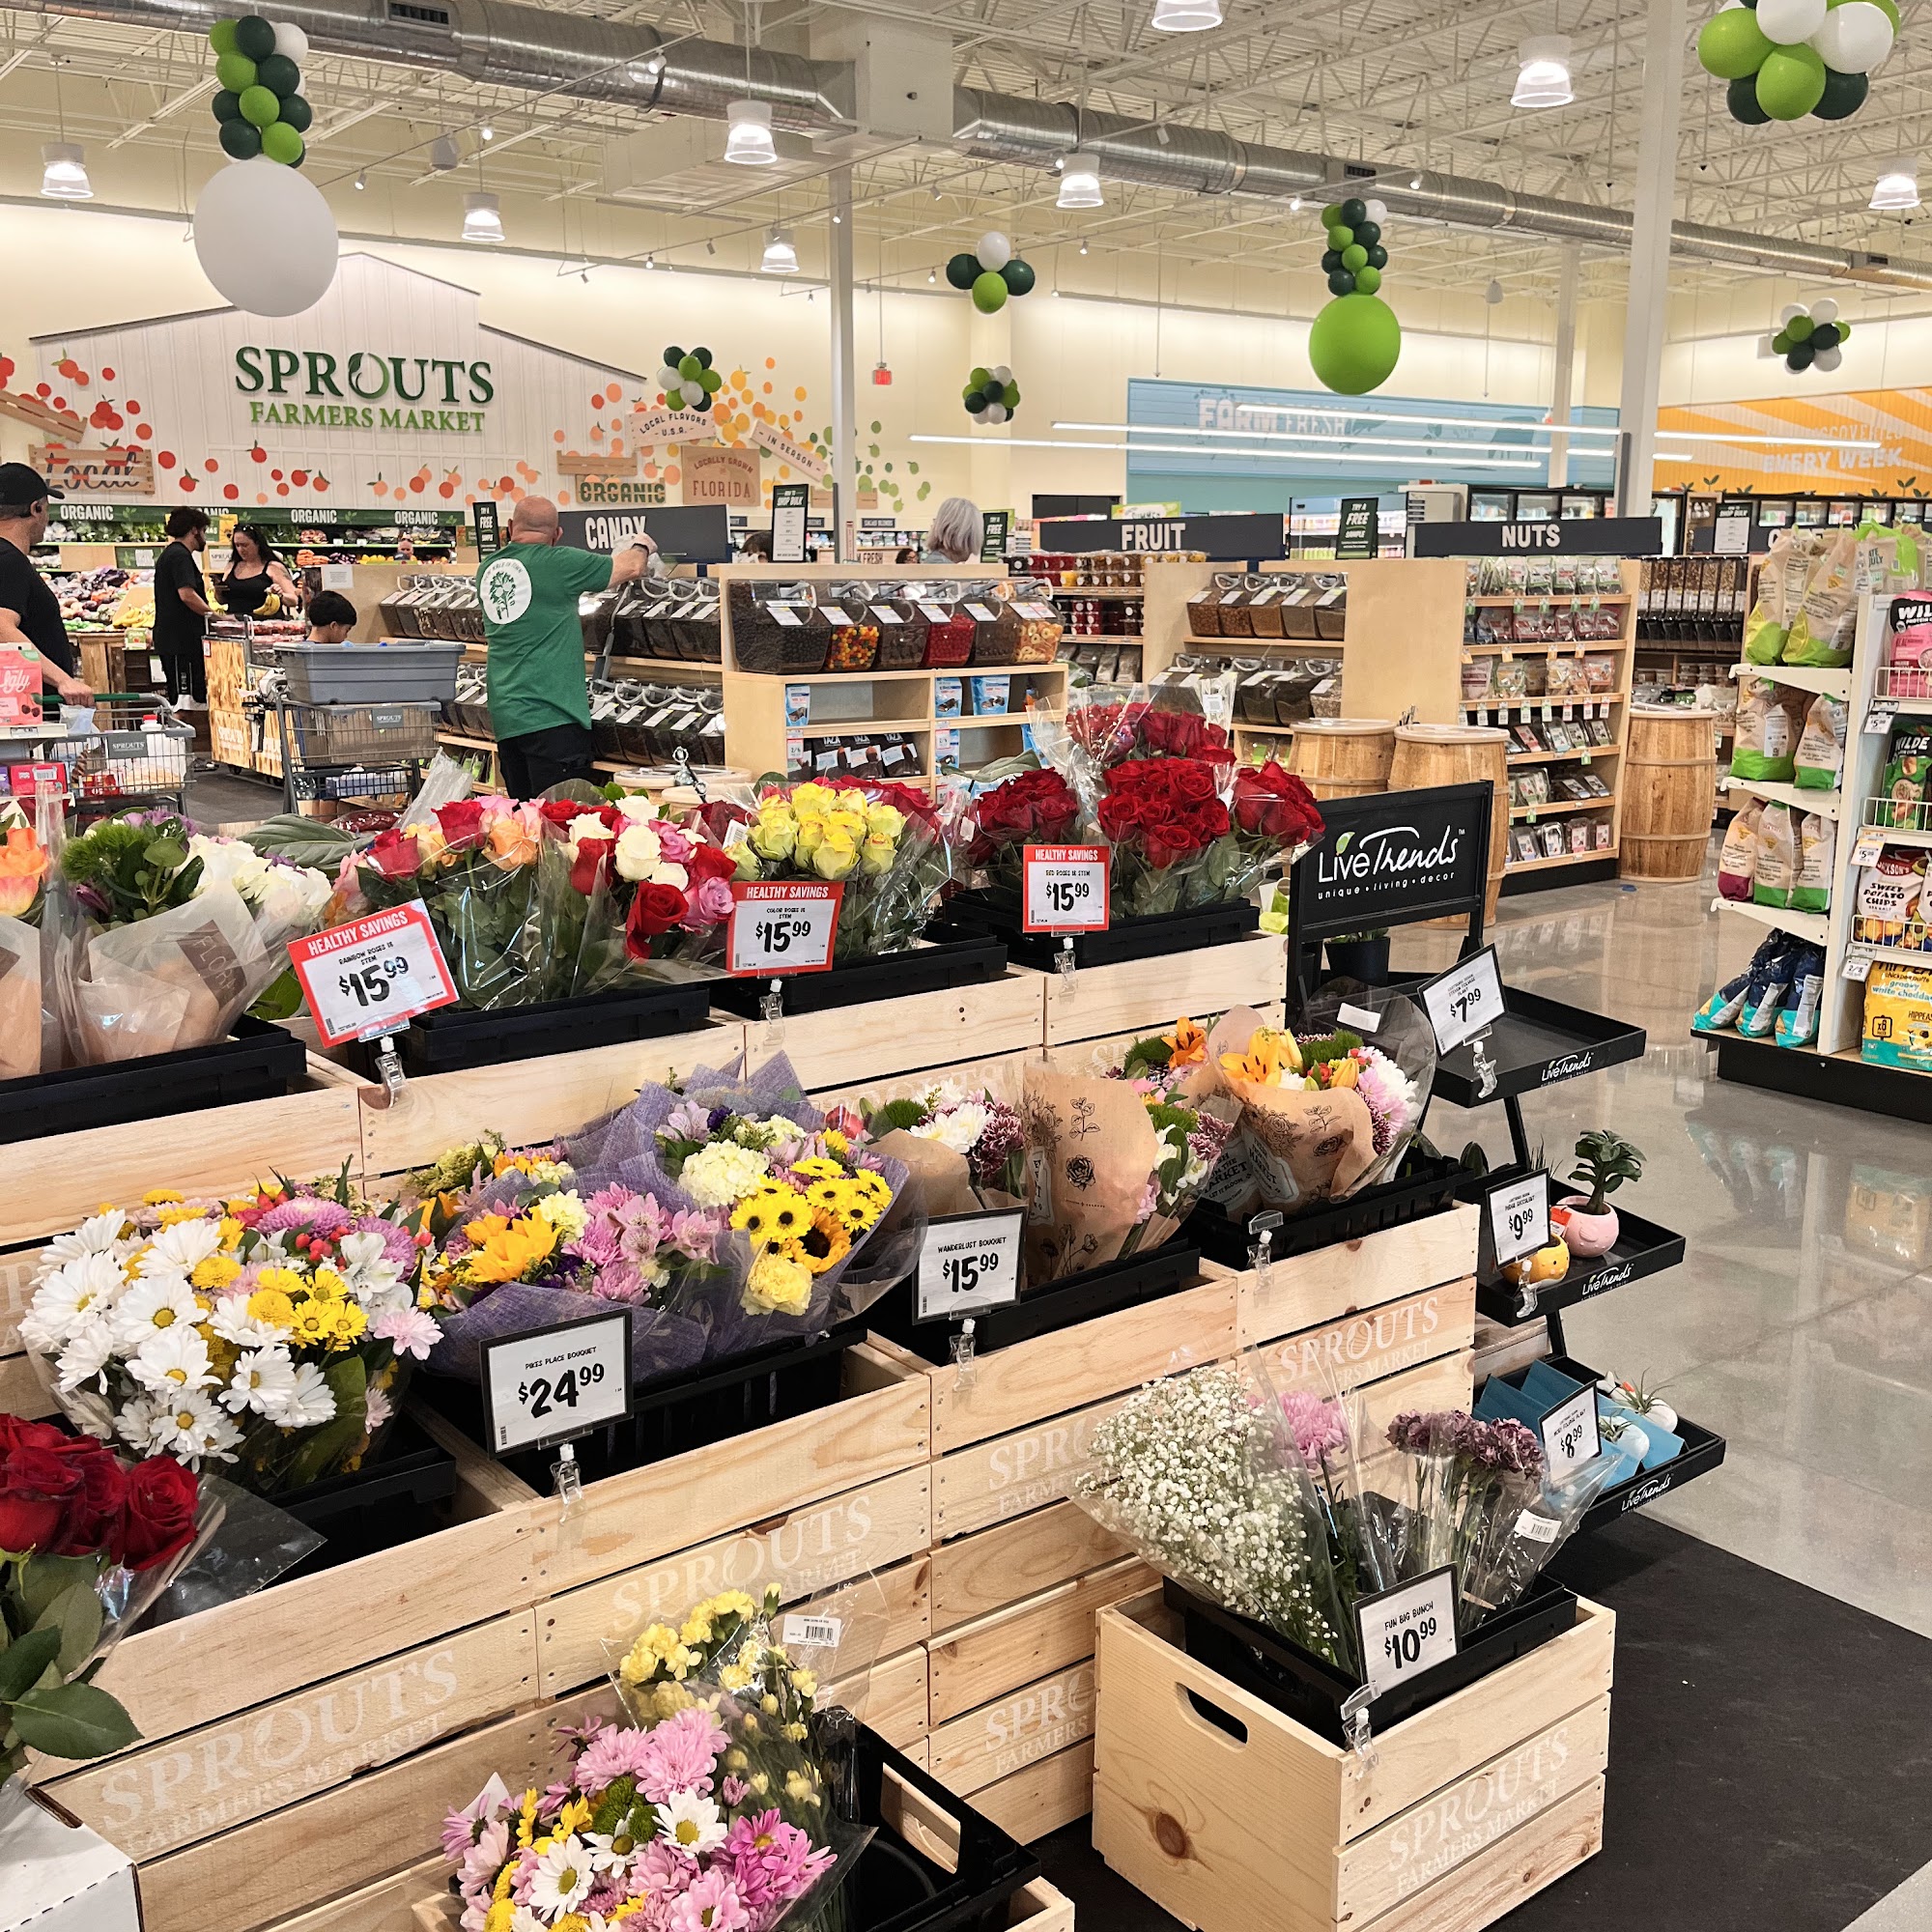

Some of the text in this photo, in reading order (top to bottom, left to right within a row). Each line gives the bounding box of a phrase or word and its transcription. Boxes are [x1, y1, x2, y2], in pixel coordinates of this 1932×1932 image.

[236, 346, 494, 404] SPROUTS
[249, 401, 485, 433] FARMERS MARKET
[639, 412, 707, 434] LOCAL FLAVORS
[767, 435, 813, 469] IN SEASON
[1763, 446, 1903, 473] EVERY WEEK
[45, 451, 139, 490] Local
[694, 456, 724, 471] LOCALLY
[727, 457, 754, 474] GROWN
[580, 482, 666, 503] ORGANIC
[693, 480, 751, 498] FLORIDA
[60, 505, 114, 521] ORGANIC
[291, 509, 337, 524] ORGANIC
[394, 511, 439, 525] ORGANIC
[479, 516, 494, 529] FREE
[1346, 512, 1370, 526] FREE
[585, 516, 645, 550] CANDY
[986, 525, 1002, 535] FREE
[1122, 523, 1185, 551] FRUIT
[1501, 525, 1560, 548] NUTS
[1898, 605, 1932, 619] WIL
[112, 741, 145, 750] SPROUTS
[1895, 737, 1930, 751] WILDE
[1035, 849, 1098, 861] HEALTHY SAVINGS
[746, 886, 829, 899] HEALTHY SAVINGS
[1318, 871, 1455, 900] unique living decor
[1863, 889, 1904, 899] POTATO
[1870, 882, 1903, 893] SWEET
[1866, 897, 1896, 906] CHIPS
[308, 911, 409, 956] HEALTHY SAVINGS
[338, 951, 366, 965] RAINBOW
[367, 946, 386, 957] ROSES
[361, 956, 377, 966] STEM
[1872, 985, 1931, 1002] white chedda
[1889, 980, 1919, 991] groovy
[938, 1236, 1007, 1254] WANDERLUST BOUQUET
[1280, 1296, 1438, 1384] SPROUTS
[525, 1347, 597, 1370] PIKES PLACE BOUQUET
[1365, 1339, 1432, 1378] MARKET
[611, 1495, 872, 1633] SPROUTS
[1384, 1601, 1434, 1631] FUN BIG BUNCH
[985, 1668, 1094, 1751] SPRO
[101, 1650, 459, 1830] SPROUTS
[995, 1715, 1088, 1775] FARMERS
[126, 1711, 445, 1855] FARMERS MARKET
[1389, 1727, 1569, 1872] SPROUTS
[1397, 1776, 1560, 1898] FARMERS MARKET
